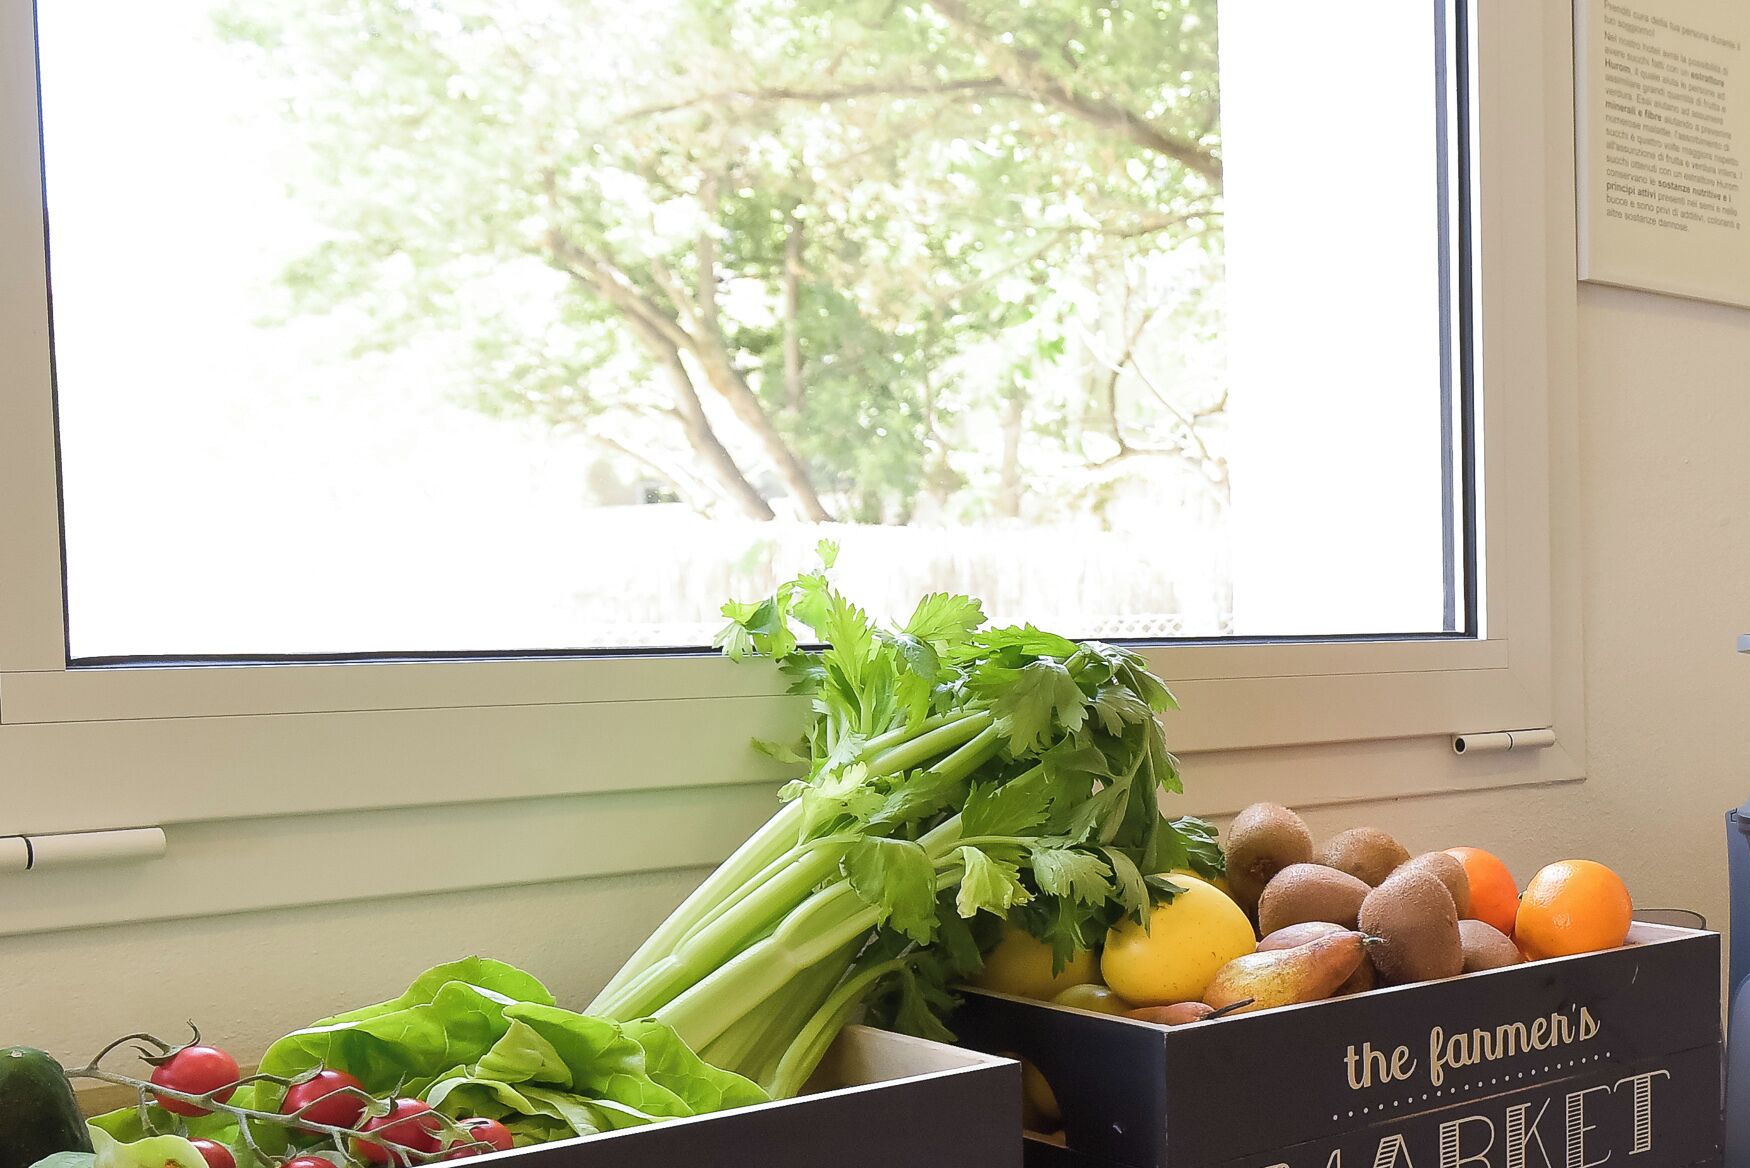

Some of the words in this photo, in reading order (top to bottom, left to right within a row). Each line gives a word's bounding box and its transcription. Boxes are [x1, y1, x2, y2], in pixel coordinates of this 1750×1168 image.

[1606, 102, 1636, 115] minerali
[1644, 110, 1662, 122] fibre
[1607, 182, 1635, 195] principi
[1637, 188, 1656, 198] attivi
[1658, 181, 1690, 193] sostanze
[1607, 194, 1628, 206] bucce
[1624, 213, 1656, 225] sostanze
[1344, 1042, 1416, 1090] the
[1429, 1003, 1600, 1087] farmer's
